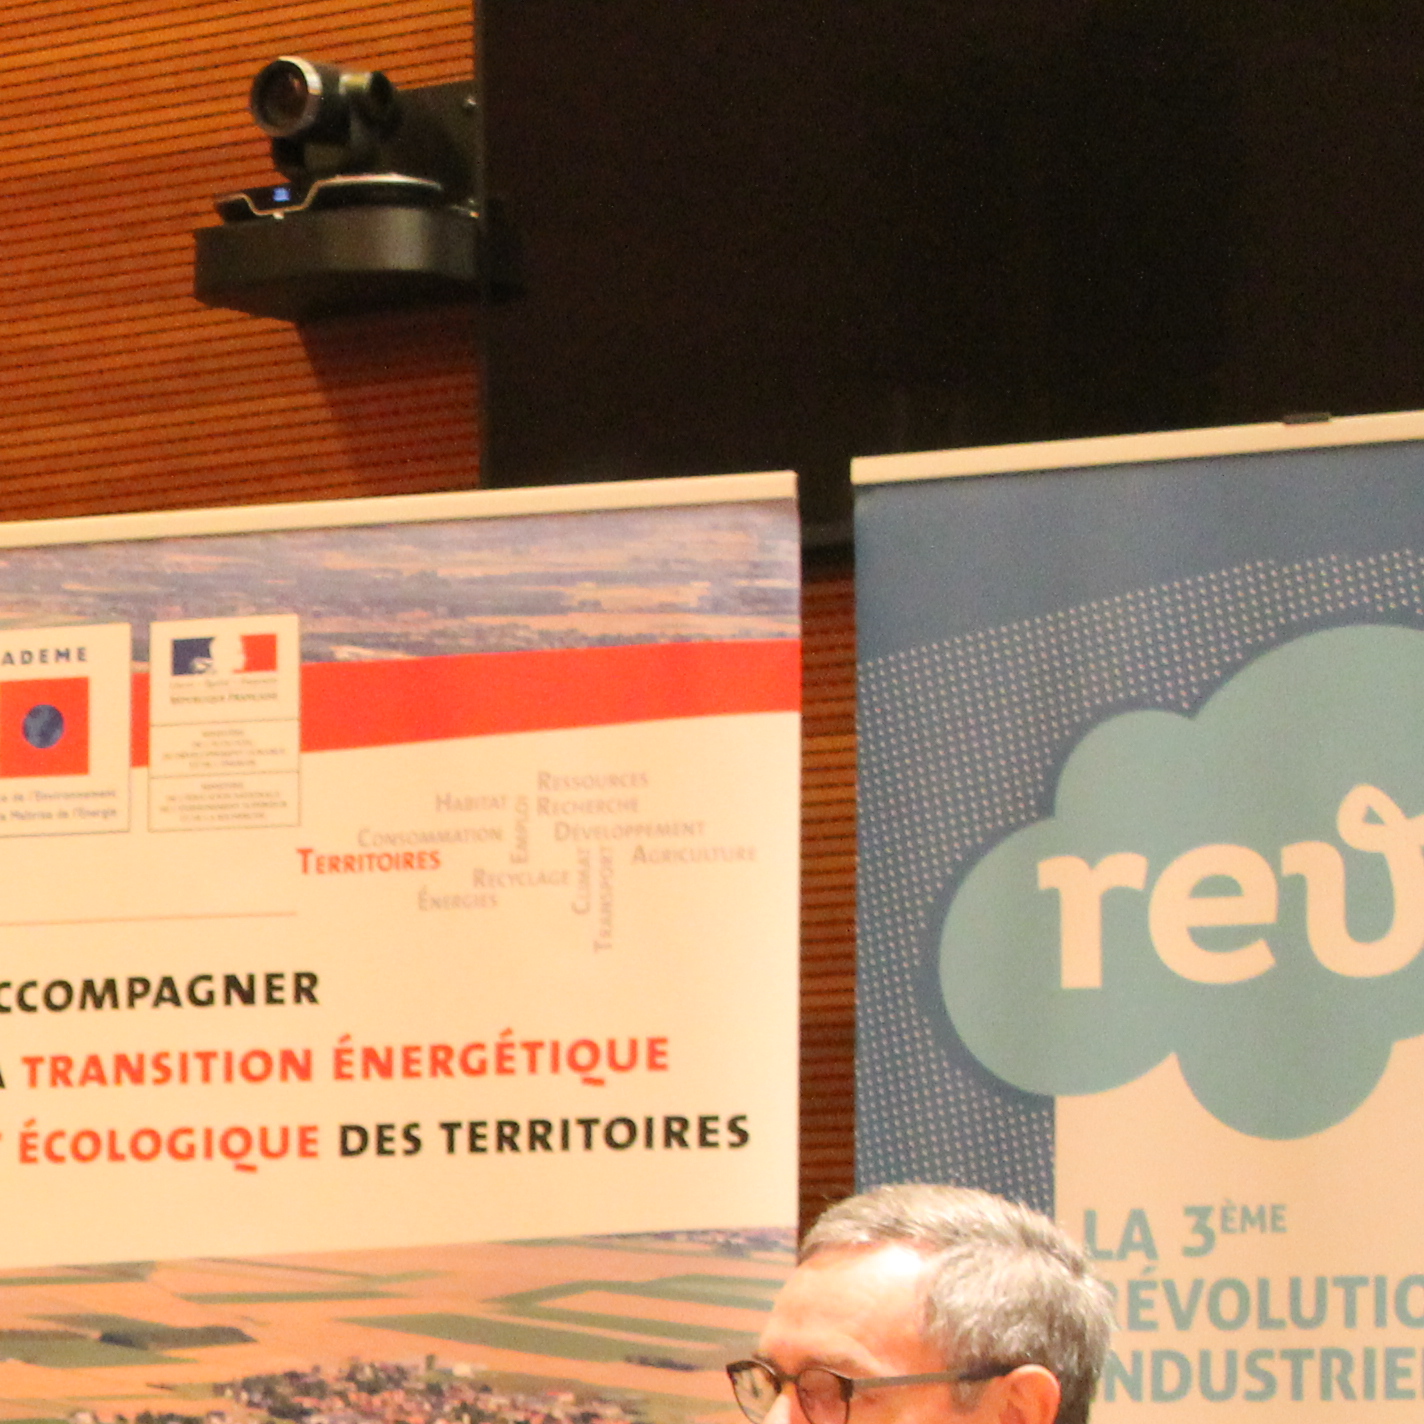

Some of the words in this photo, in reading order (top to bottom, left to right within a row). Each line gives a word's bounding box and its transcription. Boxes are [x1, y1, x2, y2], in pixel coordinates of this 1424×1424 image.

[2, 646, 87, 666] ADEME
[297, 847, 442, 876] TERRITOIRES
[21, 1047, 314, 1089] TRANSITION
[333, 1027, 670, 1087] ÉNERGÉTIQUE
[19, 1118, 320, 1173] ÉCOLOGIQUE
[339, 1121, 423, 1157] DES
[440, 1114, 751, 1155] TERRITOIRES
[1083, 1208, 1160, 1261] LA
[1105, 1265, 1424, 1332] ÉVOLUTIO
[1103, 1347, 1424, 1404] NDUSTRIE
